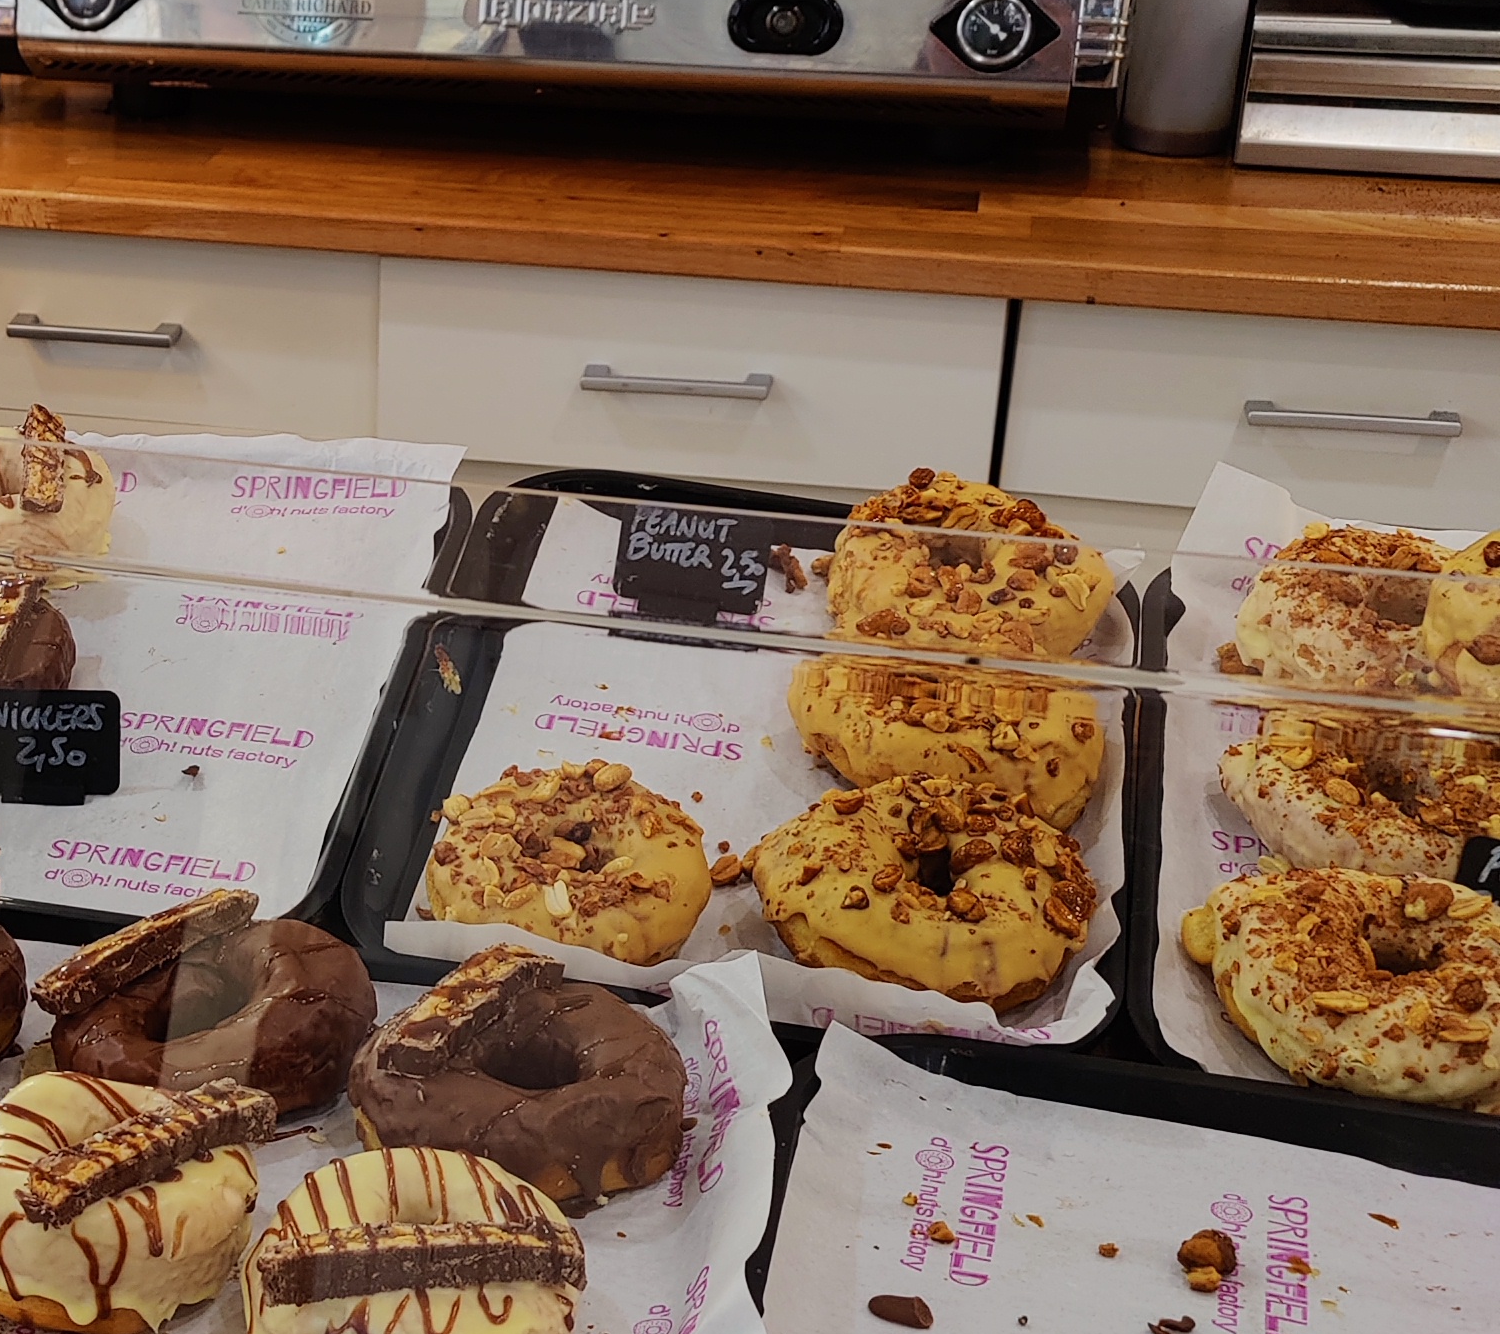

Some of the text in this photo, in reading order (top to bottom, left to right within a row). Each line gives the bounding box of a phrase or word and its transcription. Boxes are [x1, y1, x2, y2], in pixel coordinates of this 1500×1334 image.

[231, 475, 408, 501] SPRINGFIELD
[289, 507, 329, 516] nuts
[332, 505, 395, 519] factory
[120, 712, 314, 750] SPRINGFIELD
[16, 736, 87, 773] 2,50
[180, 743, 224, 759] nuts
[227, 748, 297, 769] factory
[47, 839, 257, 883] SPRINGFIELD
[114, 877, 161, 895] nuts
[163, 883, 206, 898] fact
[948, 1141, 1009, 1286] SPRINGFIELD
[1211, 1279, 1246, 1334] factory
